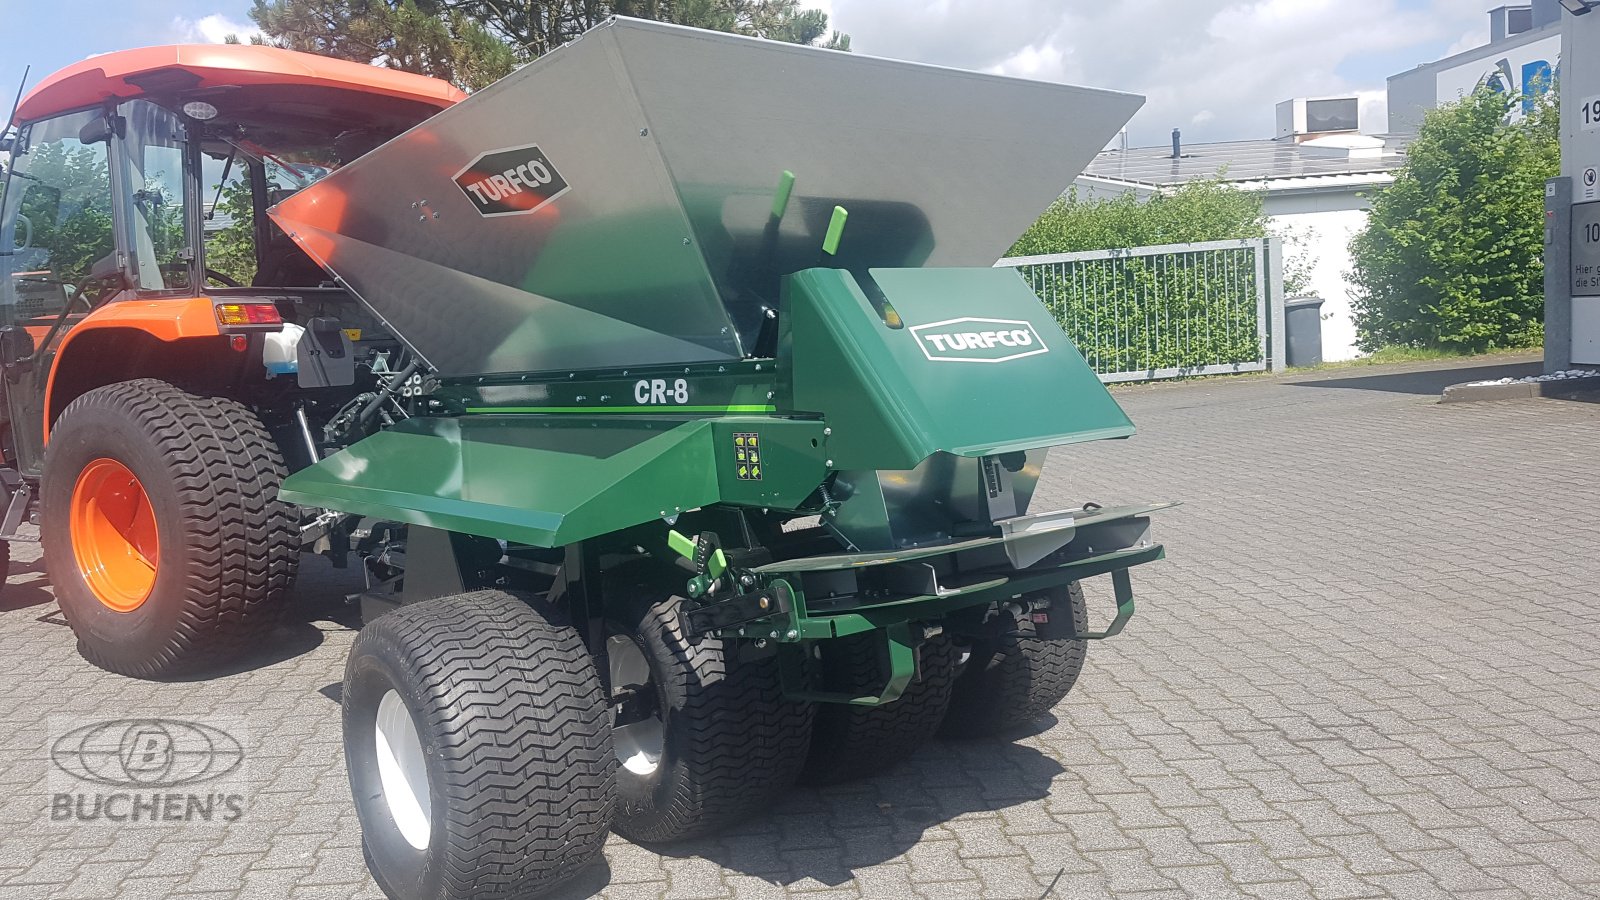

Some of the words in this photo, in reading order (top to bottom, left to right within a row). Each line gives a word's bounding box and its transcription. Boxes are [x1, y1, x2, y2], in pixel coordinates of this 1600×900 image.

[466, 160, 552, 205] TURFCO
[1584, 222, 1600, 243] 10
[1575, 264, 1593, 274] Hier
[1575, 278, 1588, 288] die
[1590, 276, 1600, 287] St
[924, 329, 1032, 351] TURFCO
[634, 379, 689, 404] CR-8
